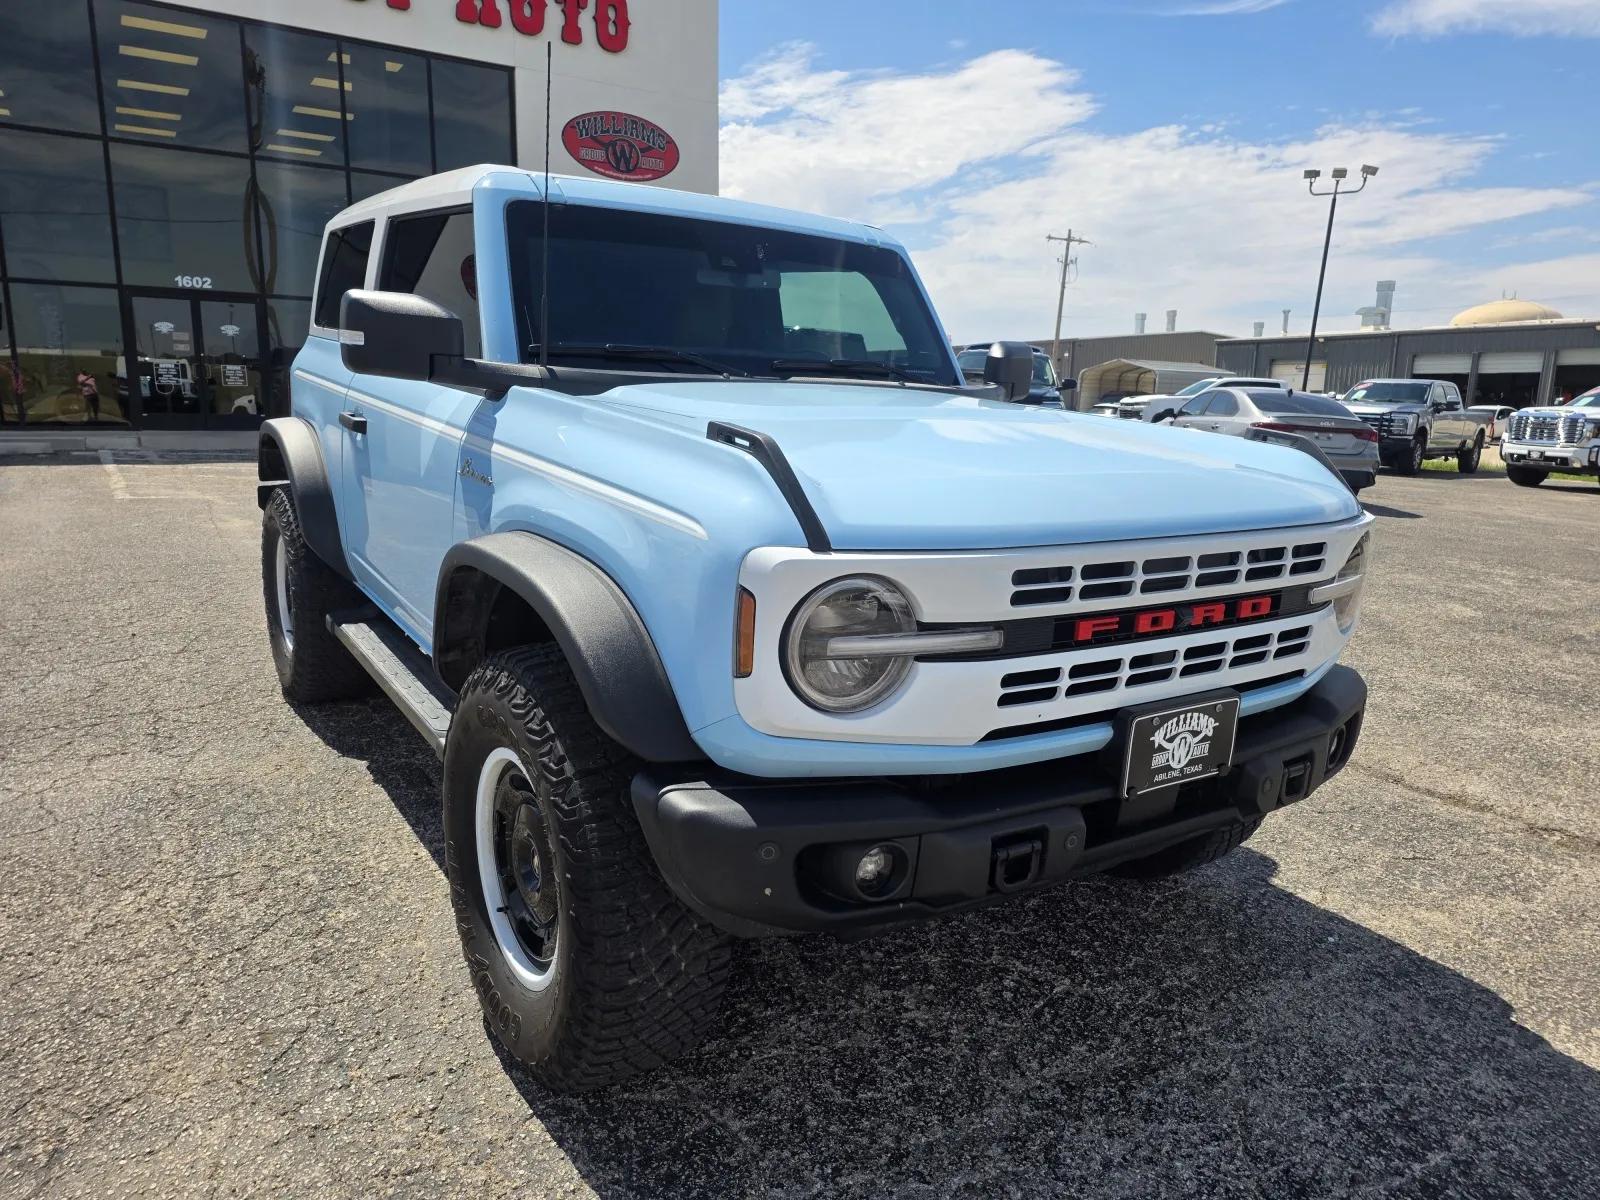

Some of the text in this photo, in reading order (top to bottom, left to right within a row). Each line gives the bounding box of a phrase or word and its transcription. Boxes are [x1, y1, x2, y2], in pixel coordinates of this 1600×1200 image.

[575, 114, 667, 152] WILLIAMS
[174, 275, 212, 289] 1602
[1075, 596, 1272, 641] FORD
[1154, 712, 1215, 748] WILLIAMS
[1192, 743, 1210, 757] AUTO
[1153, 768, 1182, 783] ABILENE,
[1183, 763, 1203, 775] TEXAS
